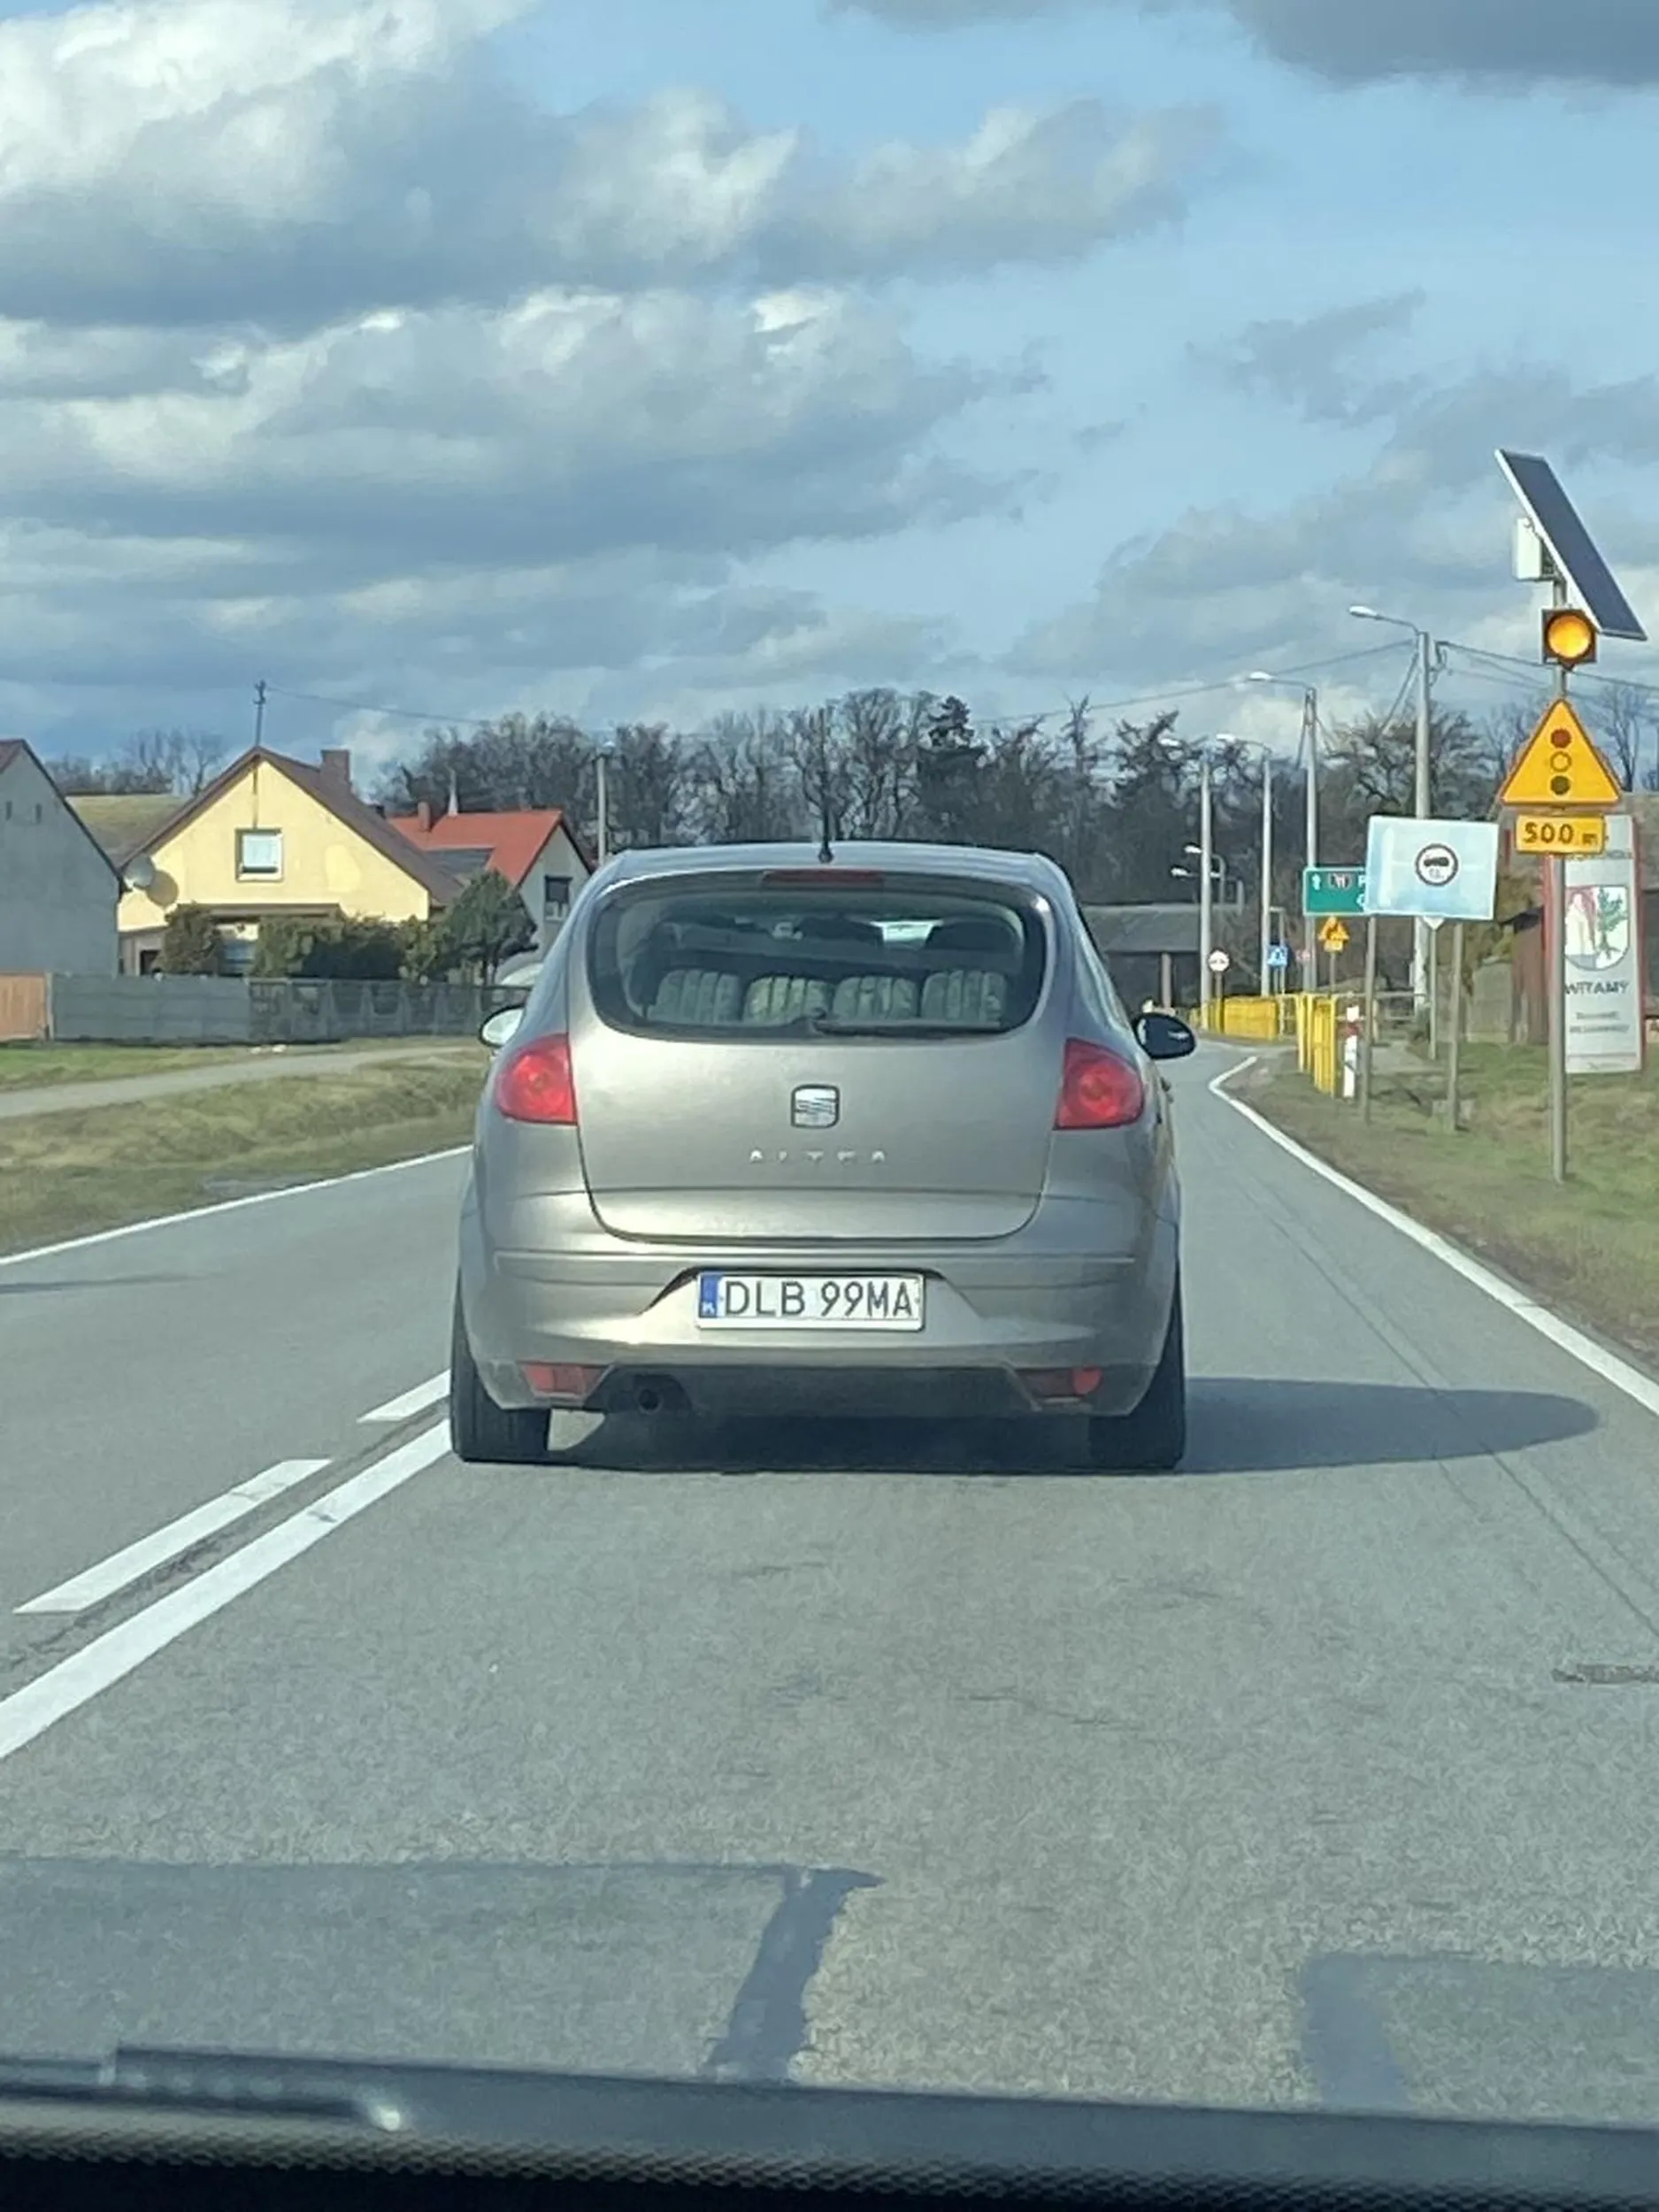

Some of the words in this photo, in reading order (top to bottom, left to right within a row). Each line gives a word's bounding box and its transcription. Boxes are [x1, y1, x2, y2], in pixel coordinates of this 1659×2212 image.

[1524, 821, 1575, 844] 500
[724, 1280, 806, 1316] DLB
[820, 1281, 912, 1317] 99MA
